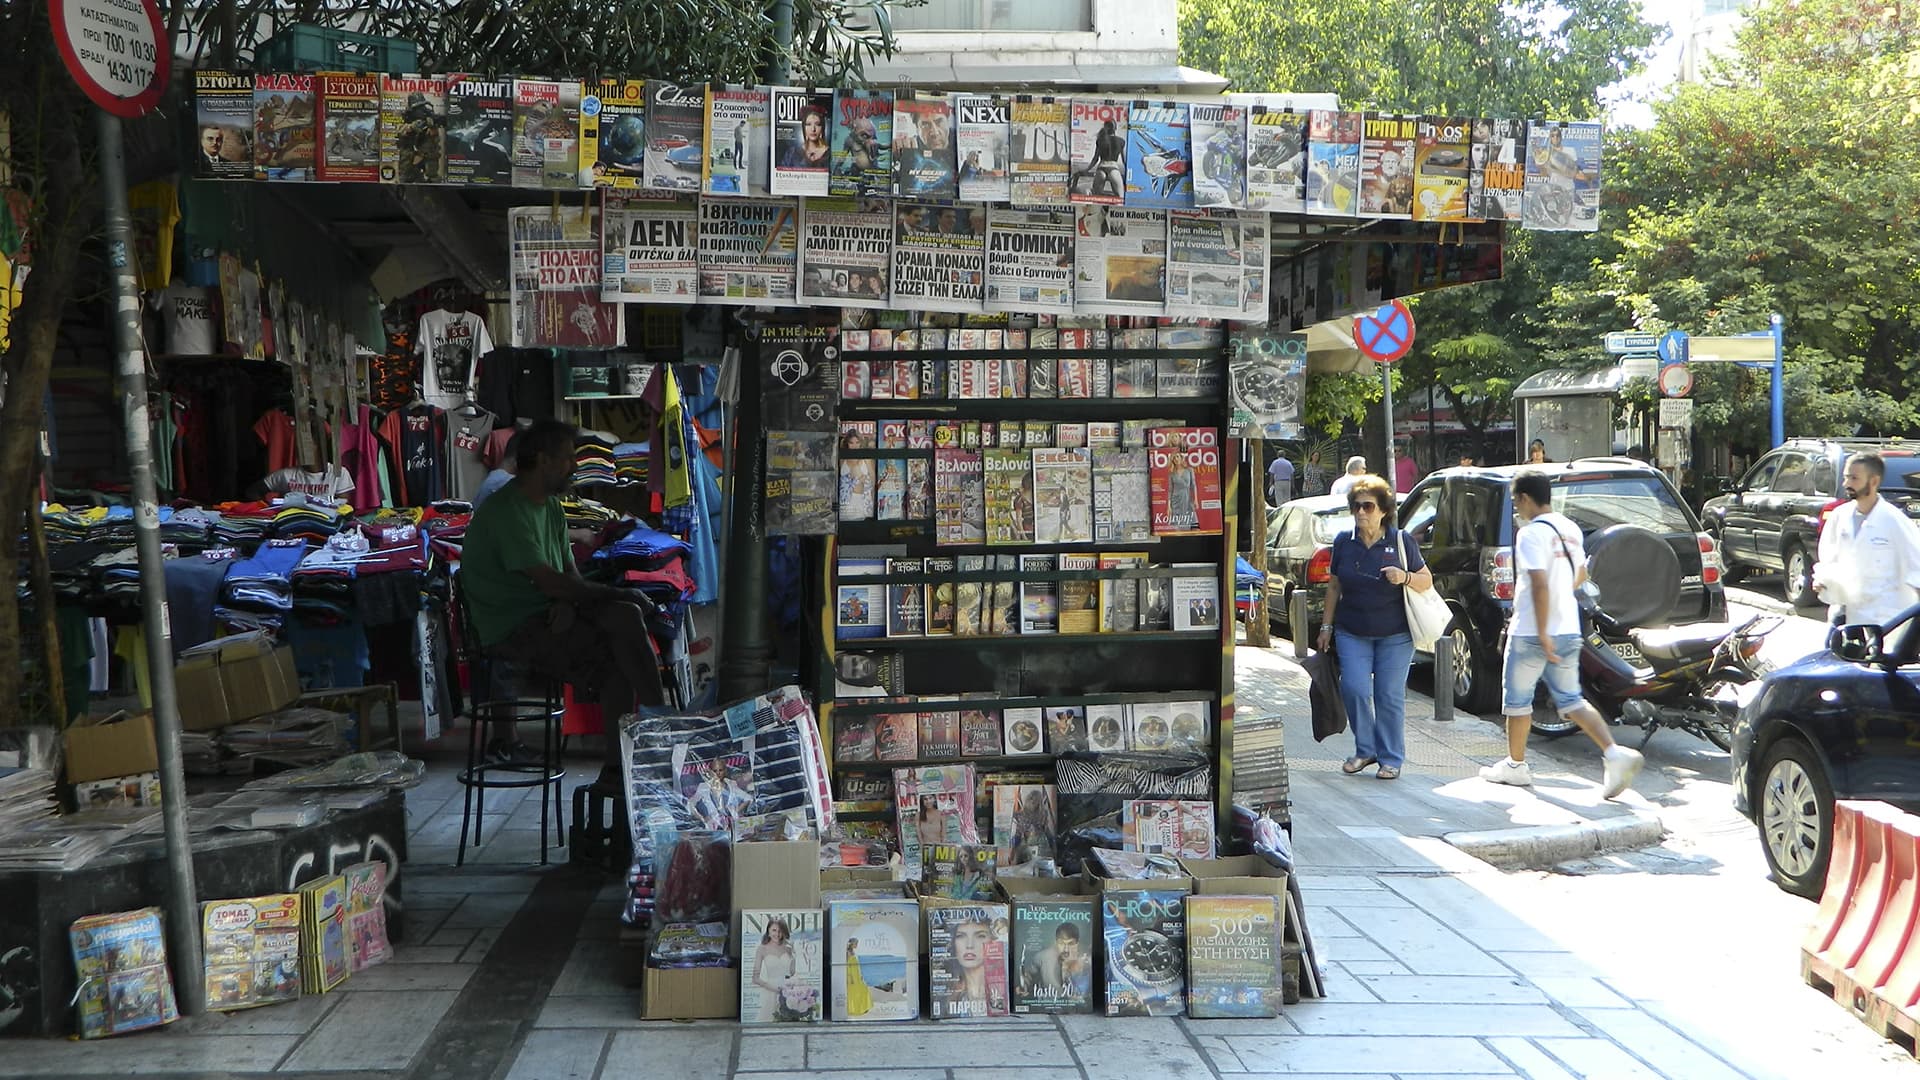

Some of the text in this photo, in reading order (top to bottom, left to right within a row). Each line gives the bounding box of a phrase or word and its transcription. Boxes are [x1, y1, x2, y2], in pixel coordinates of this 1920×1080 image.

[80, 7, 139, 33] ΚΑΤΑΣΤΗΜΑΤΩΝ
[80, 49, 105, 64] ΒΡΑΔΥ
[197, 76, 252, 88] ΙΣΤΟΡΙΑ
[324, 77, 378, 95] ΙΣΤΟΡΙΑ
[1366, 120, 1398, 137] ΤΡΙΤΟ
[701, 204, 773, 220] 18ΧΡΟΝΗ
[1110, 210, 1124, 219] Κου
[1126, 210, 1150, 220] Κλουξ
[630, 220, 684, 247] ΔΕΝ
[700, 238, 763, 253] η αρχηγός
[806, 238, 840, 251] ΑΛΛΟΙ
[990, 232, 1069, 254] ΑΤΟΜΙΚΗ
[629, 248, 674, 261] αντέχω
[700, 254, 713, 265] της
[714, 254, 744, 266] μαφίας
[746, 255, 760, 266] της
[896, 251, 932, 267] ΟΡΑΜΑ
[989, 252, 1019, 264] βόμβα
[540, 268, 566, 285] ΣΤΟ
[896, 265, 950, 282] Η ΠΑΝΑΓΙΑ
[989, 265, 1014, 276] θέλει
[1023, 267, 1067, 279] Ερντογάν
[895, 280, 925, 295] ΣΩΖΕΙ
[928, 283, 949, 297] ΤΗΝ
[762, 328, 825, 336] IN THE MIX
[1152, 429, 1216, 447] brda
[936, 458, 982, 472] Βελονά
[985, 455, 1031, 471] Βελονά
[1154, 450, 1217, 468] brda
[391, 532, 409, 542] 5 €
[1016, 907, 1091, 924] Πετρετζίκης
[1209, 918, 1253, 938] 500
[1195, 935, 1268, 946] ΤΑΞΙΔΙΑ ΖΩΗΣ
[1192, 947, 1270, 960] ΣΤΗ ΓΕΥΣΗ
